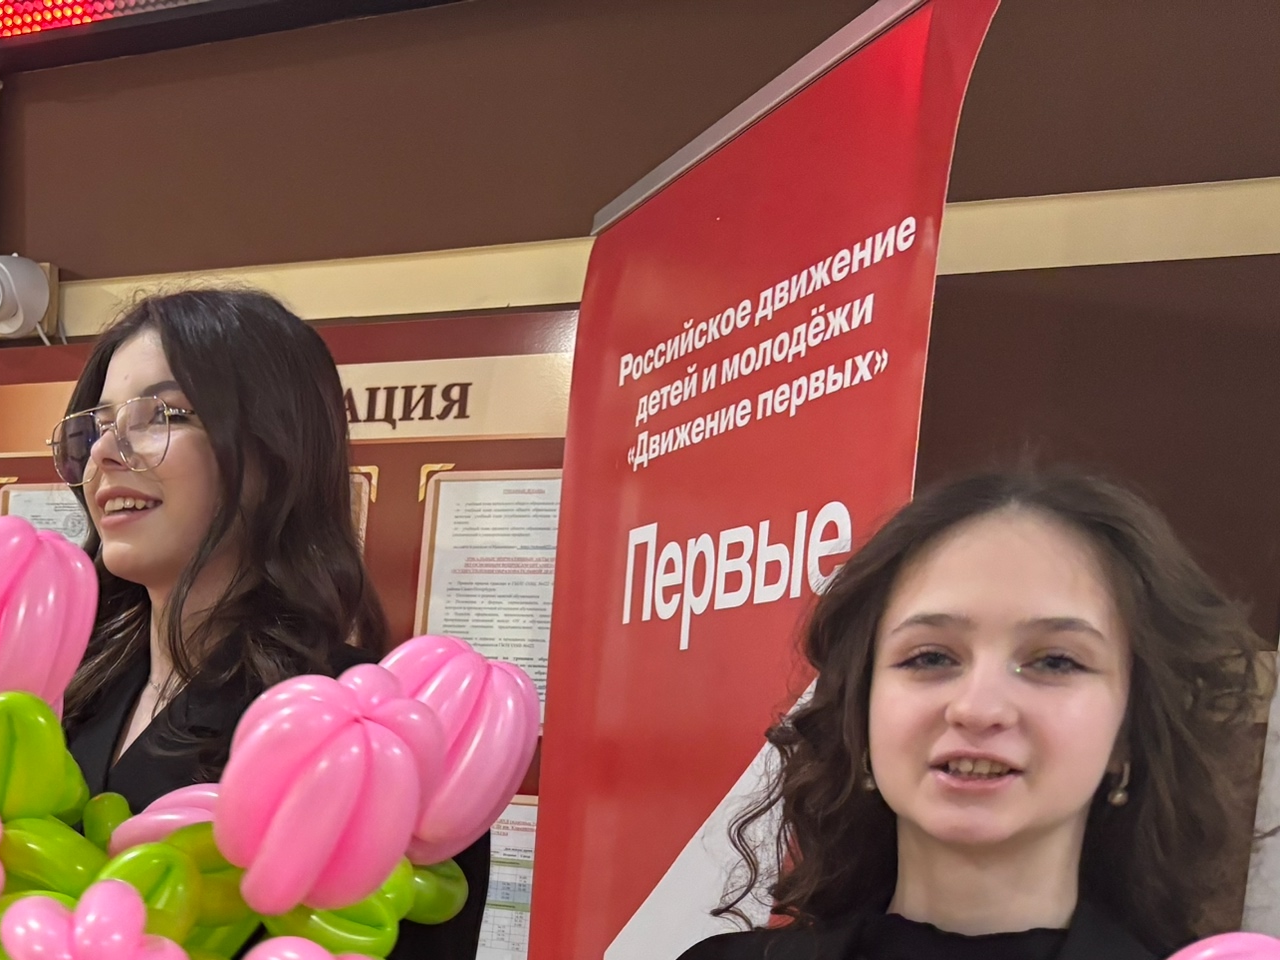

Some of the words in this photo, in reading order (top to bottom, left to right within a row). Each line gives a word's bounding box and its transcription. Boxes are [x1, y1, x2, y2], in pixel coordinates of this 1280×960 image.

[618, 298, 753, 387] Российское
[754, 215, 918, 326] движение
[634, 359, 699, 428] детей
[701, 363, 718, 396] и
[720, 292, 876, 388] молодёжи
[344, 382, 473, 430] АЦИЯ
[627, 399, 753, 472] «Движение
[755, 348, 889, 422] первых»
[621, 500, 852, 650] Первые
